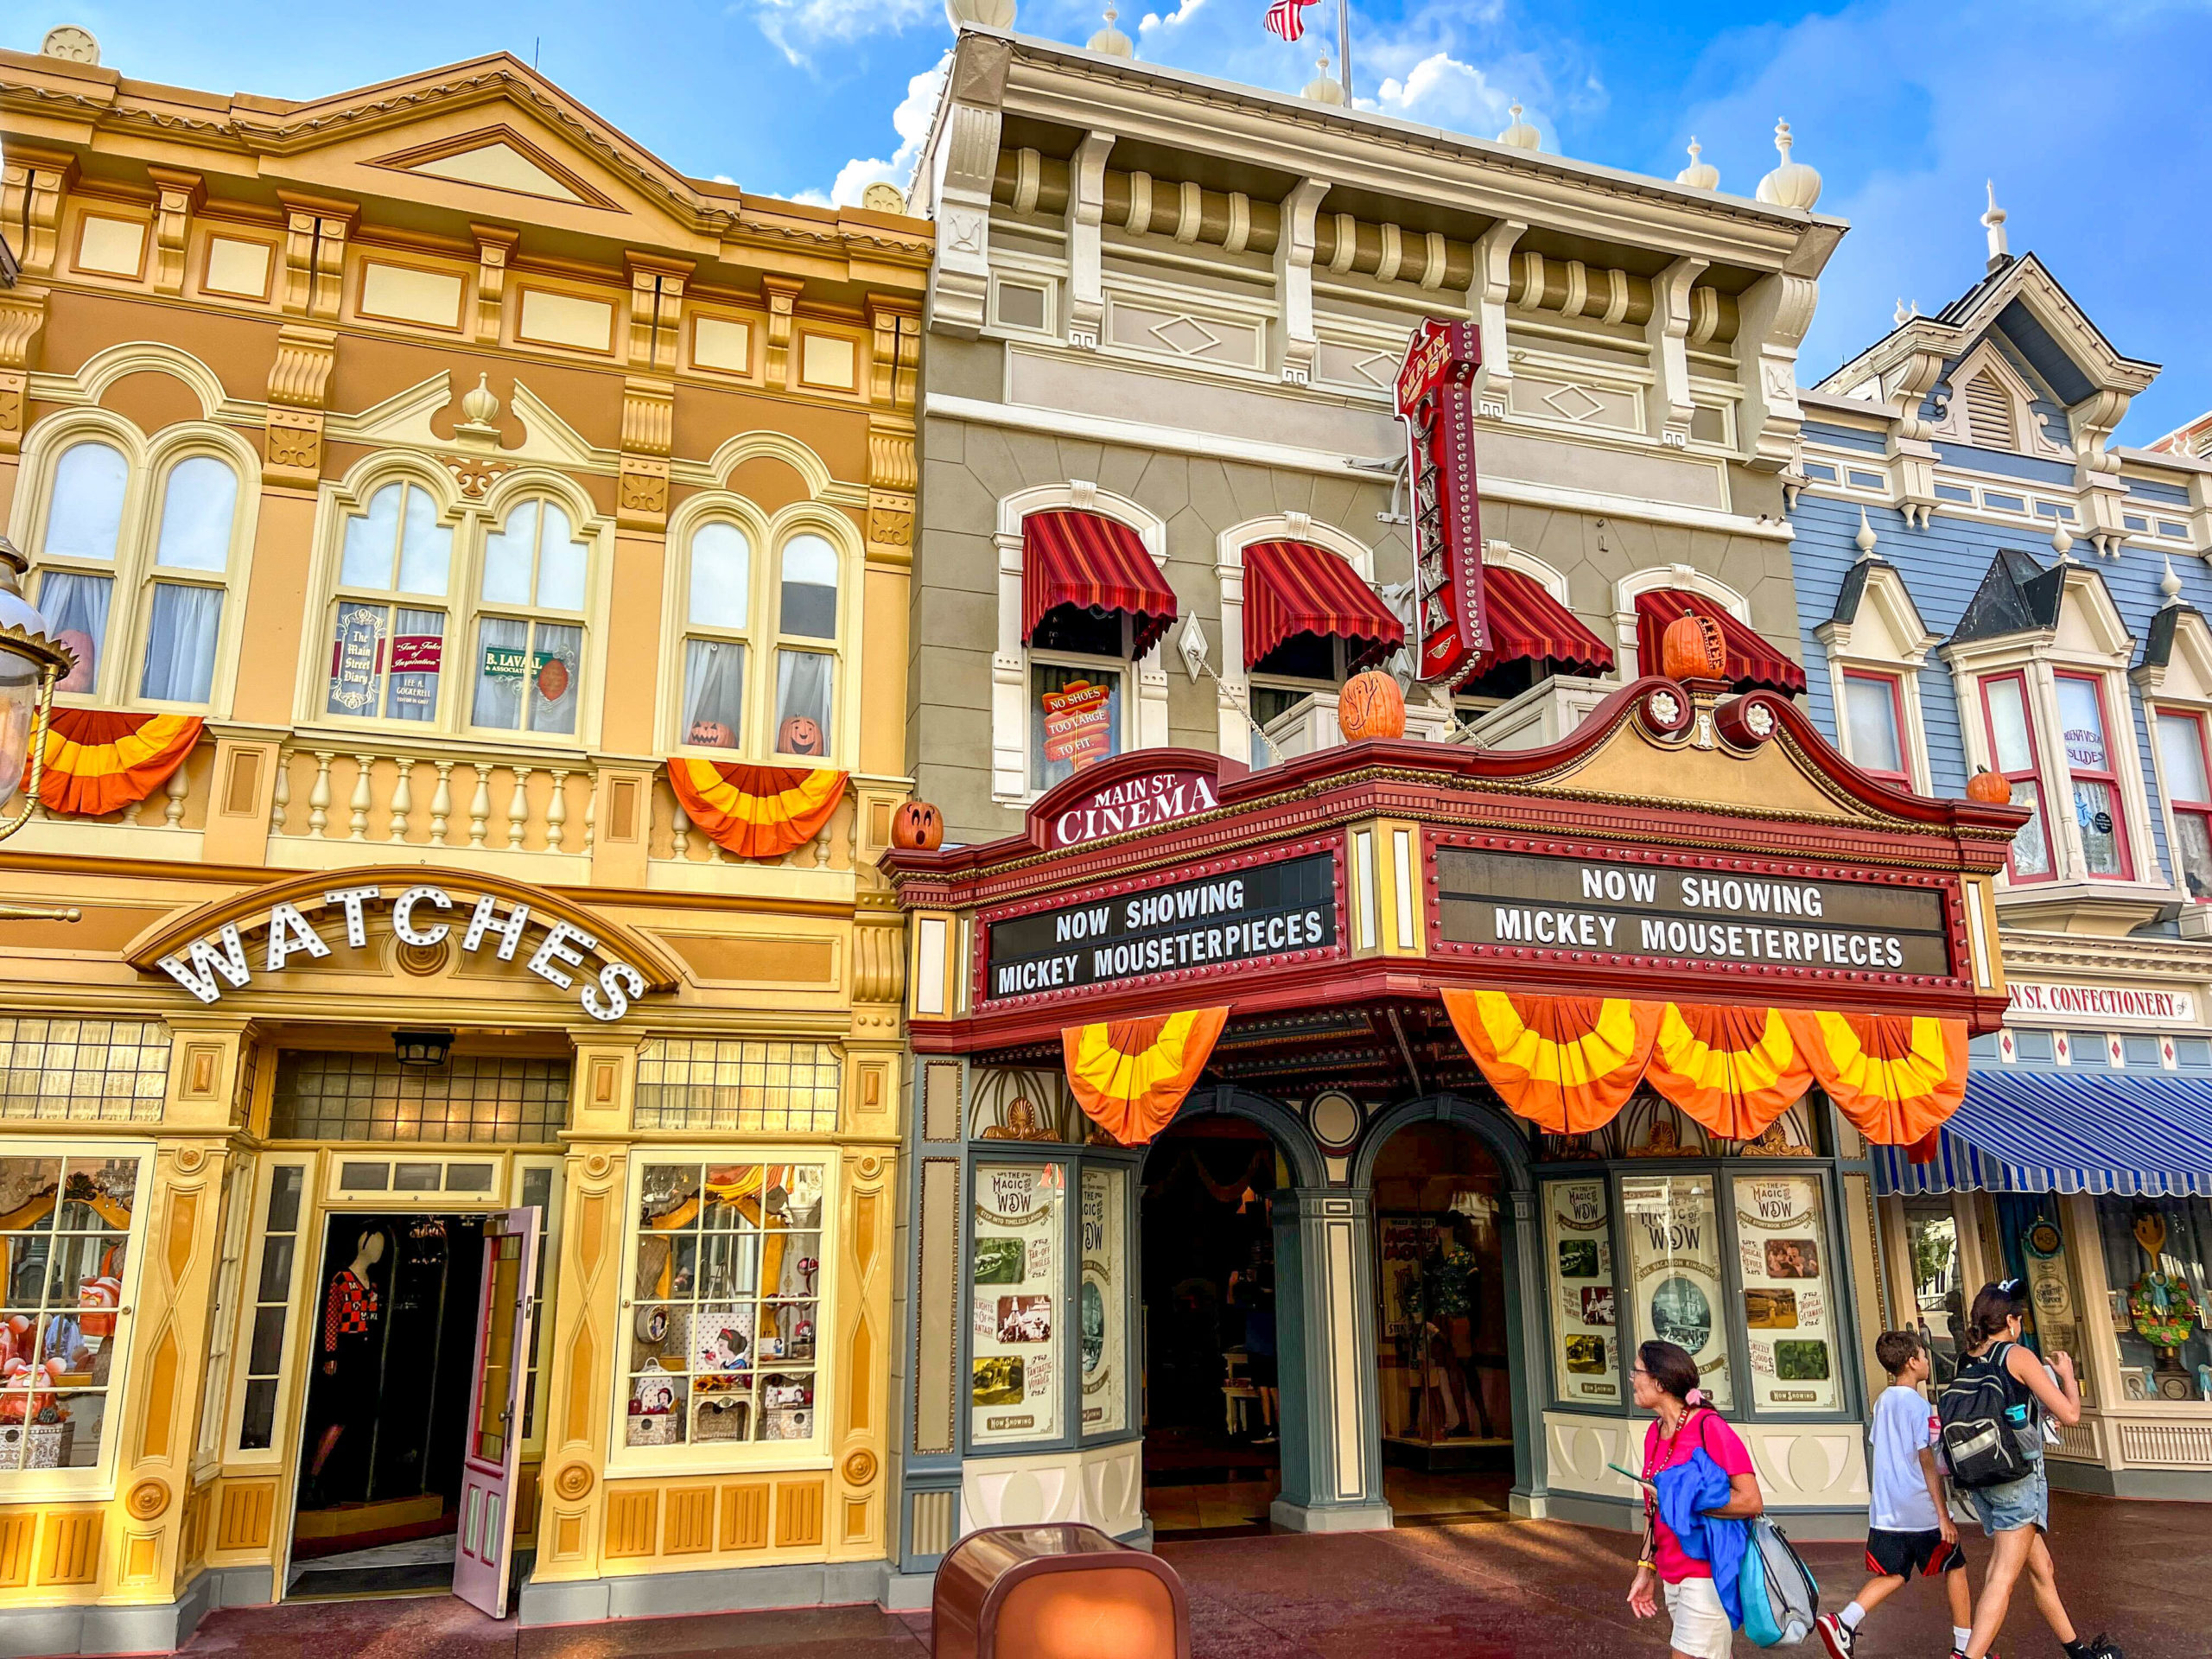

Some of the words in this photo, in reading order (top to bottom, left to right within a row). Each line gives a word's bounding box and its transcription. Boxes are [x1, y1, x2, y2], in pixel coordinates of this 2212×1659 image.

[1402, 330, 1446, 407] MAIN
[1428, 342, 1452, 380] ST.
[1412, 386, 1453, 643] CINEMA
[353, 631, 369, 643] The
[347, 644, 372, 657] Main
[411, 650, 423, 658] of
[486, 653, 498, 664] B.
[346, 658, 371, 671] Street
[344, 671, 368, 685] Diary
[404, 678, 415, 687] LEE
[1050, 698, 1066, 710] NO
[1068, 689, 1101, 705] SHOES
[1048, 721, 1071, 735] TOO
[1072, 710, 1106, 727] LARGE
[2068, 749, 2104, 765] SLIDES
[1094, 778, 1147, 807] MAIN
[1152, 774, 1178, 794] ST.
[1057, 776, 1219, 844] CINEMA
[1581, 868, 1657, 903] NOW
[1681, 876, 1823, 918] SHOWING
[1055, 906, 1110, 943] NOW
[1126, 879, 1244, 930] SHOWING
[1495, 907, 1617, 948] MICKEY
[1641, 918, 1903, 969] MOUSETERPIECES
[156, 885, 645, 1022] WATCHES
[998, 955, 1078, 995] MICKEY
[1095, 911, 1323, 978] MOUSETERPIECES
[2024, 985, 2047, 1010] ST.
[2050, 987, 2175, 1016] CONFECTIONERY
[991, 1175, 1023, 1194] MAGIC
[1084, 1192, 1094, 1200] THE
[1567, 1189, 1590, 1204] MAGIC
[1751, 1186, 1782, 1202] MAGIC
[995, 1192, 1032, 1214] WDW
[1084, 1204, 1096, 1216] GIC
[1756, 1200, 1791, 1218] WDW
[980, 1210, 992, 1220] STEP
[1028, 1211, 1042, 1223] LANDS
[1572, 1203, 1599, 1221] WDW
[1643, 1224, 1700, 1252] WDW
[1027, 1246, 1051, 1260] FAR-OFF
[1740, 1245, 1762, 1259] MUSICAL
[1027, 1256, 1051, 1273] JUNGLES
[1641, 1268, 1650, 1277] THE
[1653, 1260, 1683, 1269] VACATION
[1686, 1261, 1717, 1278] KINGDOM
[1798, 1300, 1821, 1313] TROPICAL
[1799, 1307, 1824, 1321] GETAWAYS
[974, 1322, 994, 1335] ANTASY
[1751, 1351, 1769, 1363] GOOD
[1026, 1362, 1052, 1378] FANTASTIC
[1027, 1373, 1051, 1390] VOYAGES
[1774, 1392, 1786, 1401] NOW
[1788, 1391, 1814, 1401] SHOWING
[990, 1418, 1004, 1430] NOW
[1005, 1417, 1032, 1429] SHOWING
